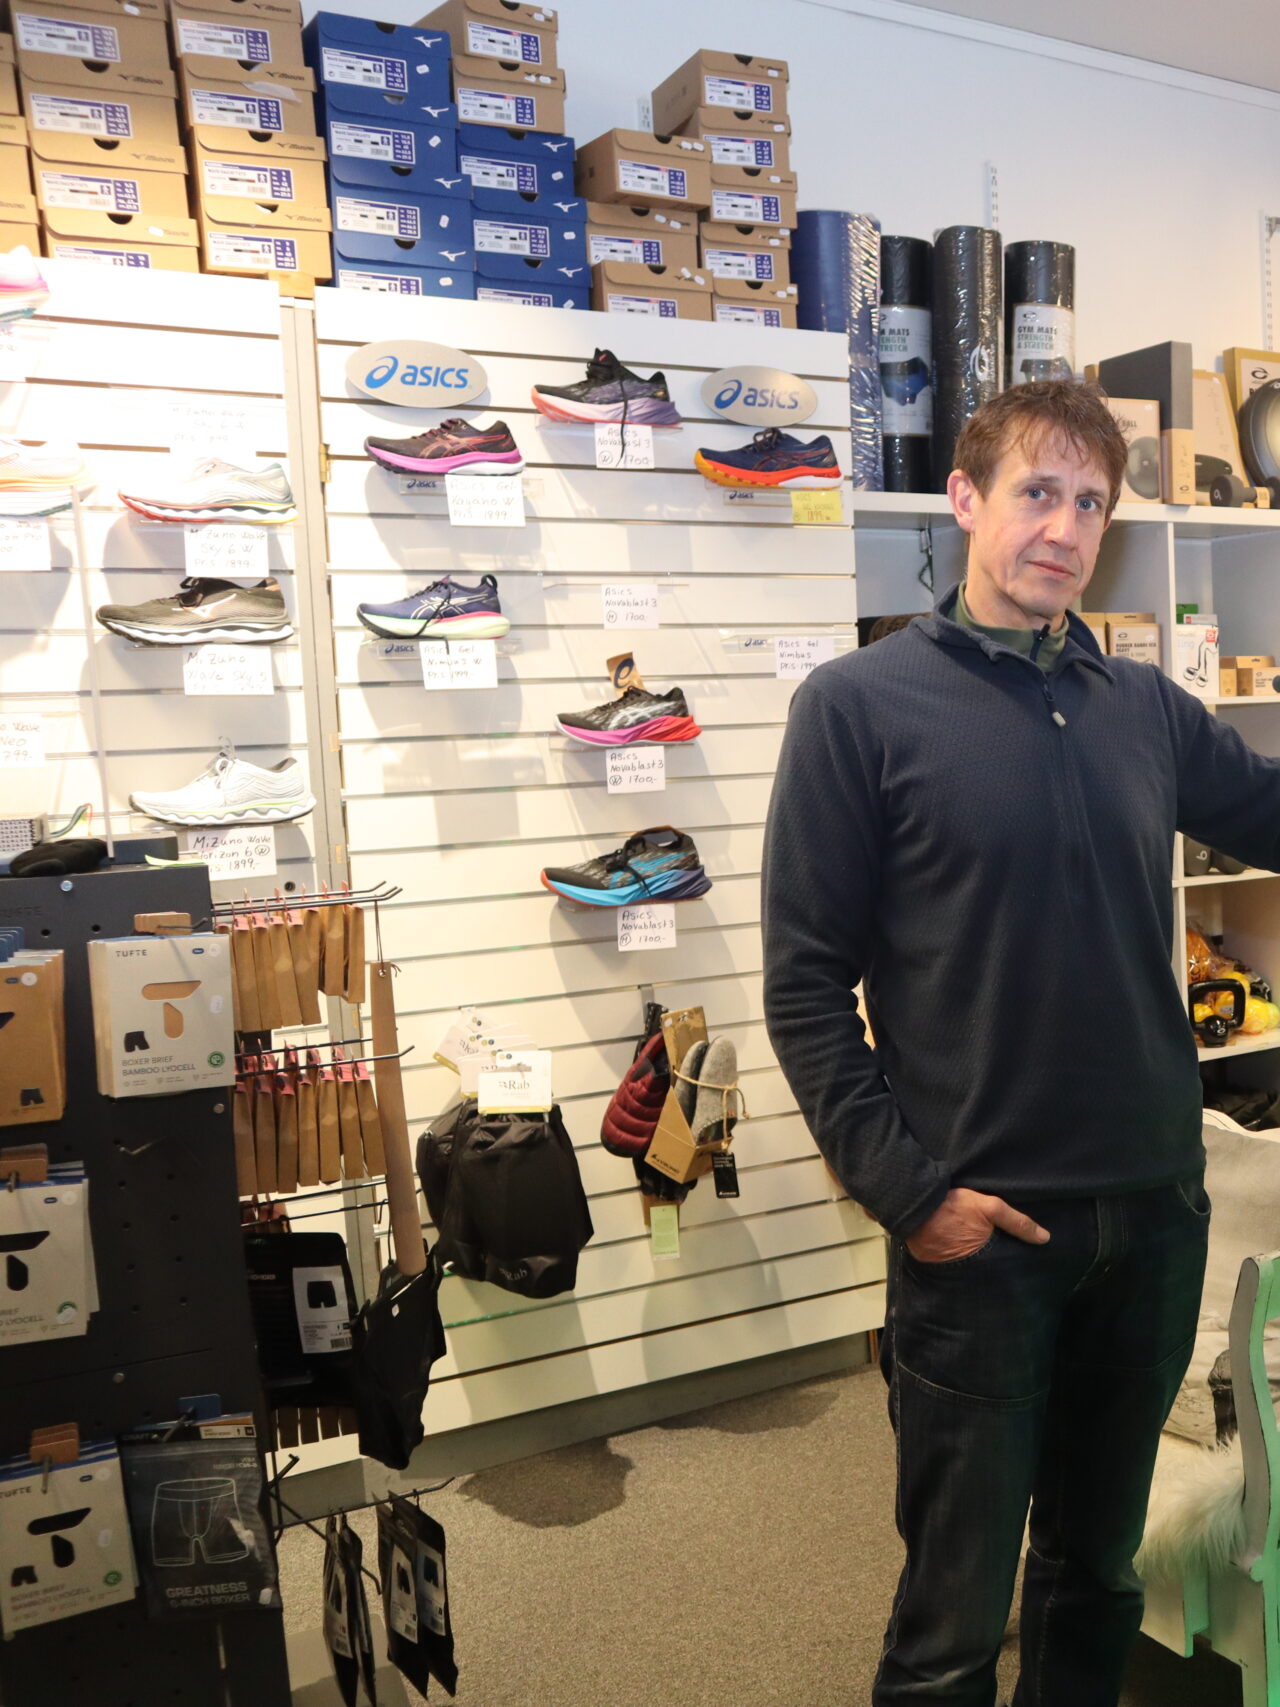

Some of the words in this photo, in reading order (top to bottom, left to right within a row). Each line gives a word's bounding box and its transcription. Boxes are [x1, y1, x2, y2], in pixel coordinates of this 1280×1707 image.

[400, 364, 469, 388] asics
[742, 385, 799, 410] asics
[115, 949, 148, 958] TUFTE
[121, 1056, 150, 1067] BOXER
[151, 1055, 174, 1064] BRIEF
[121, 1065, 160, 1077] BAMBOO
[161, 1063, 196, 1075] LYOCELL
[508, 1079, 531, 1090] Rab
[166, 1581, 249, 1599] GREATNESS
